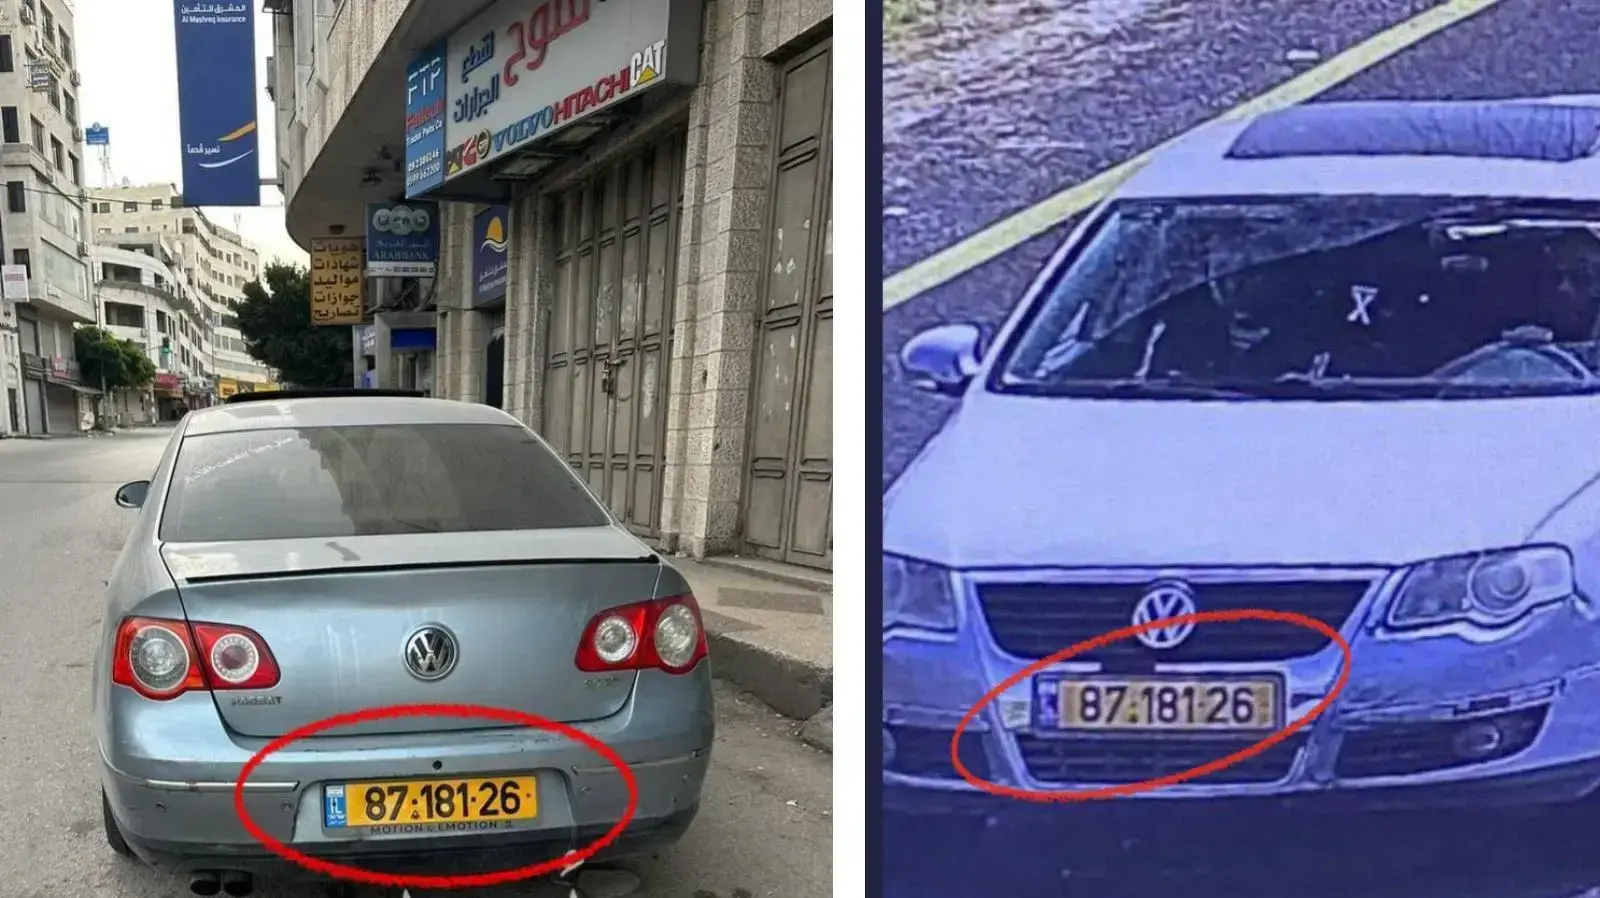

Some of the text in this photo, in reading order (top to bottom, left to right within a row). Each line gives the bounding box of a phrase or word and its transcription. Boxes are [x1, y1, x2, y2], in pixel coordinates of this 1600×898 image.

[182, 15, 246, 24] Al Mashreq Insurance
[408, 56, 441, 106] FTP
[492, 104, 553, 152] VOLVO
[553, 66, 631, 125] HITACHI
[630, 38, 667, 87] CAT
[313, 256, 359, 272] شهادات
[313, 273, 359, 289] مواليد
[314, 290, 359, 306] جوازات
[313, 305, 360, 321] تصاريح
